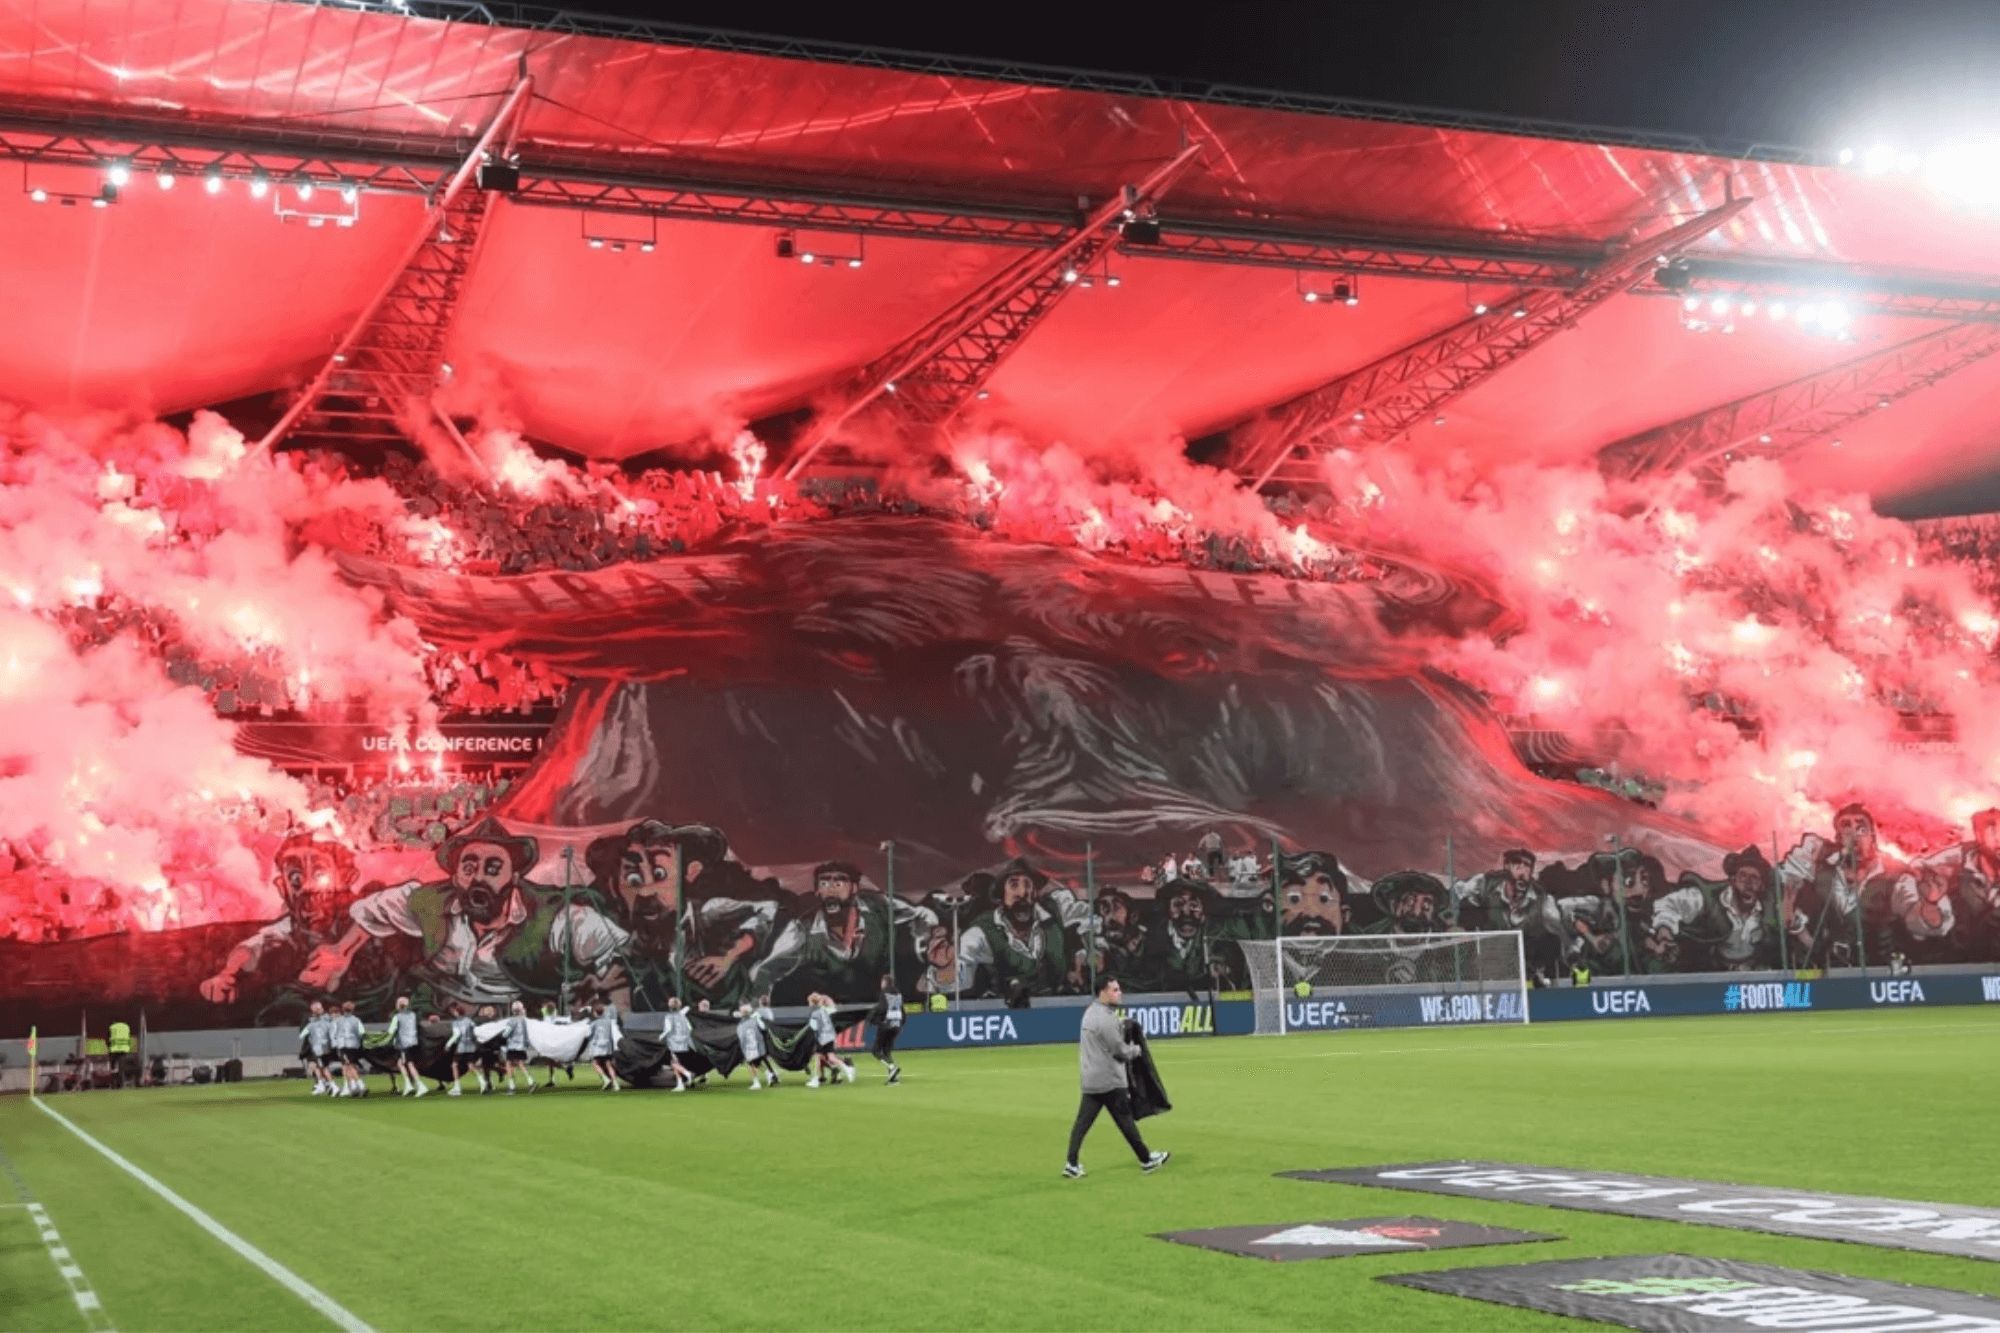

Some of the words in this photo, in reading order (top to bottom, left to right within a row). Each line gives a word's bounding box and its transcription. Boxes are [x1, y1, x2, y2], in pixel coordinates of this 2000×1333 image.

[415, 737, 533, 752] CONFERENCE
[1592, 990, 1651, 1014] UEFA
[1723, 983, 1812, 1010] #FOOTBALL
[1868, 980, 1925, 1003] UEFA
[1287, 1001, 1346, 1027] UEFA
[947, 1015, 1018, 1042] UEFA
[1377, 1165, 1699, 1202] UEFA
[1678, 1197, 2000, 1247] CON
